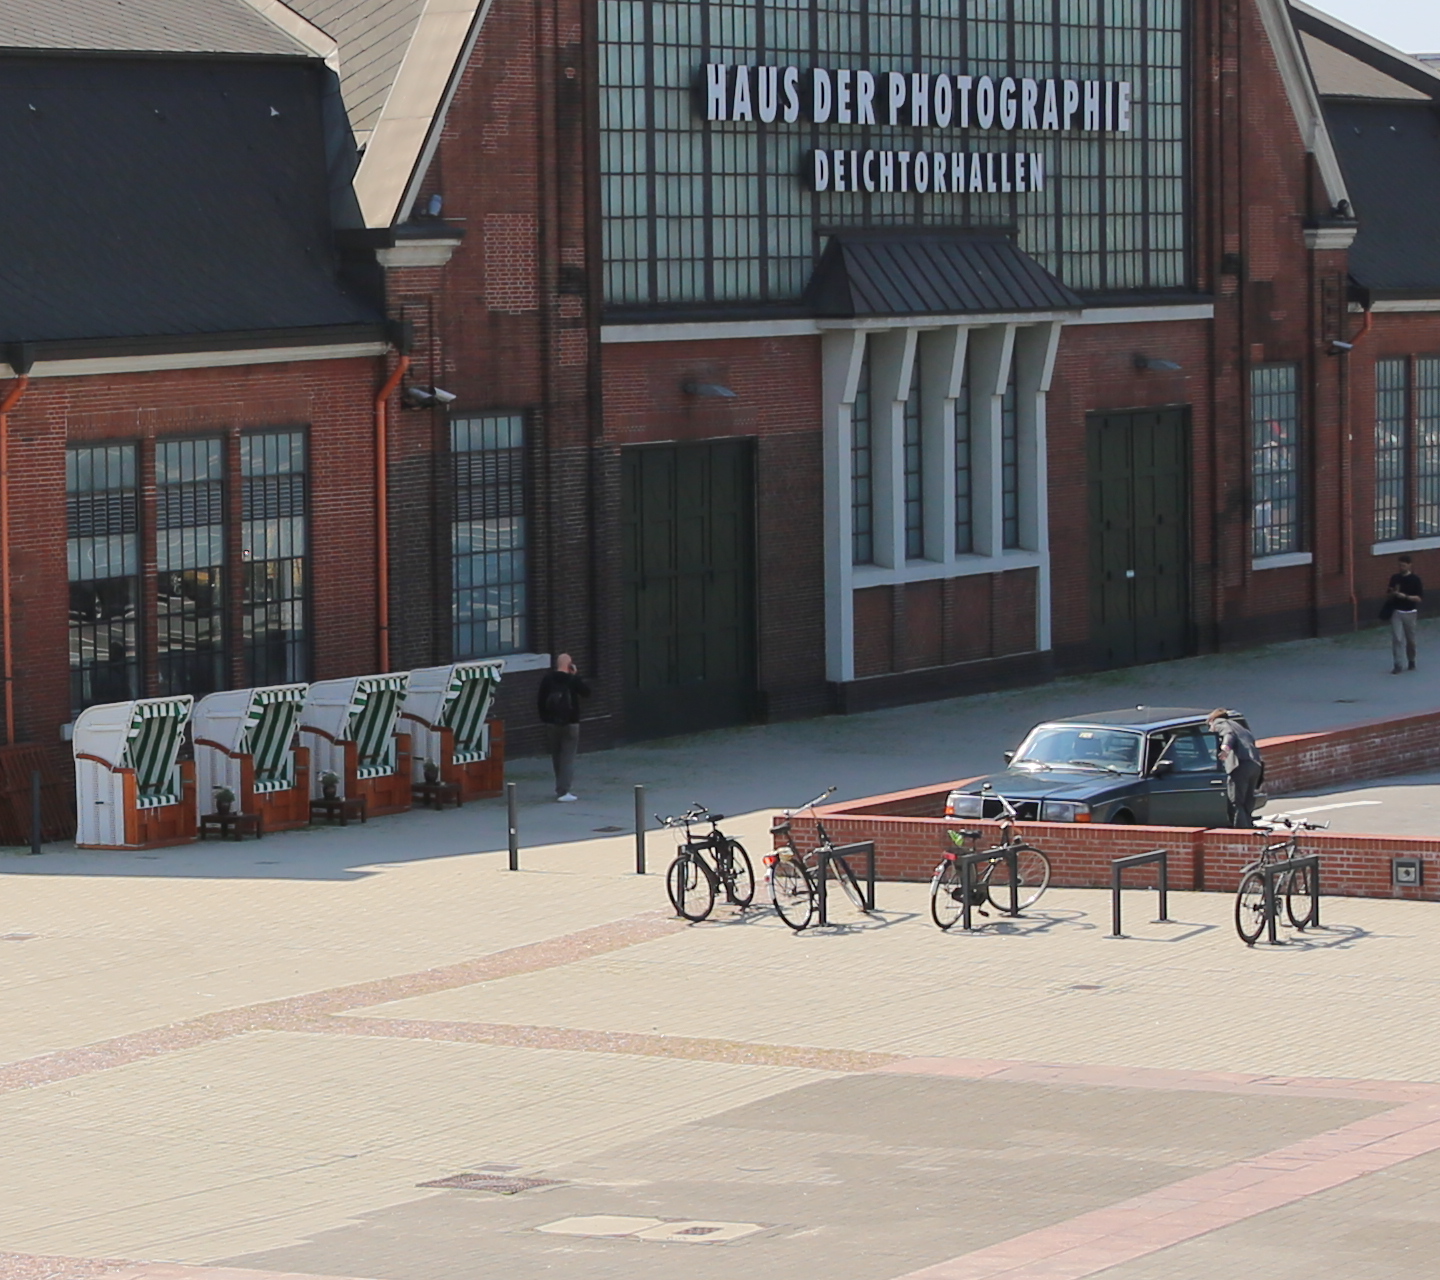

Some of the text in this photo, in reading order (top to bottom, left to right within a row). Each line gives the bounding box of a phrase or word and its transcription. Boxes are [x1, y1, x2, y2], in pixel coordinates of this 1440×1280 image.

[706, 63, 1131, 132] HAUS DER PHOTOGRAPHIE
[813, 148, 1044, 193] DEICHTORHALLEN
